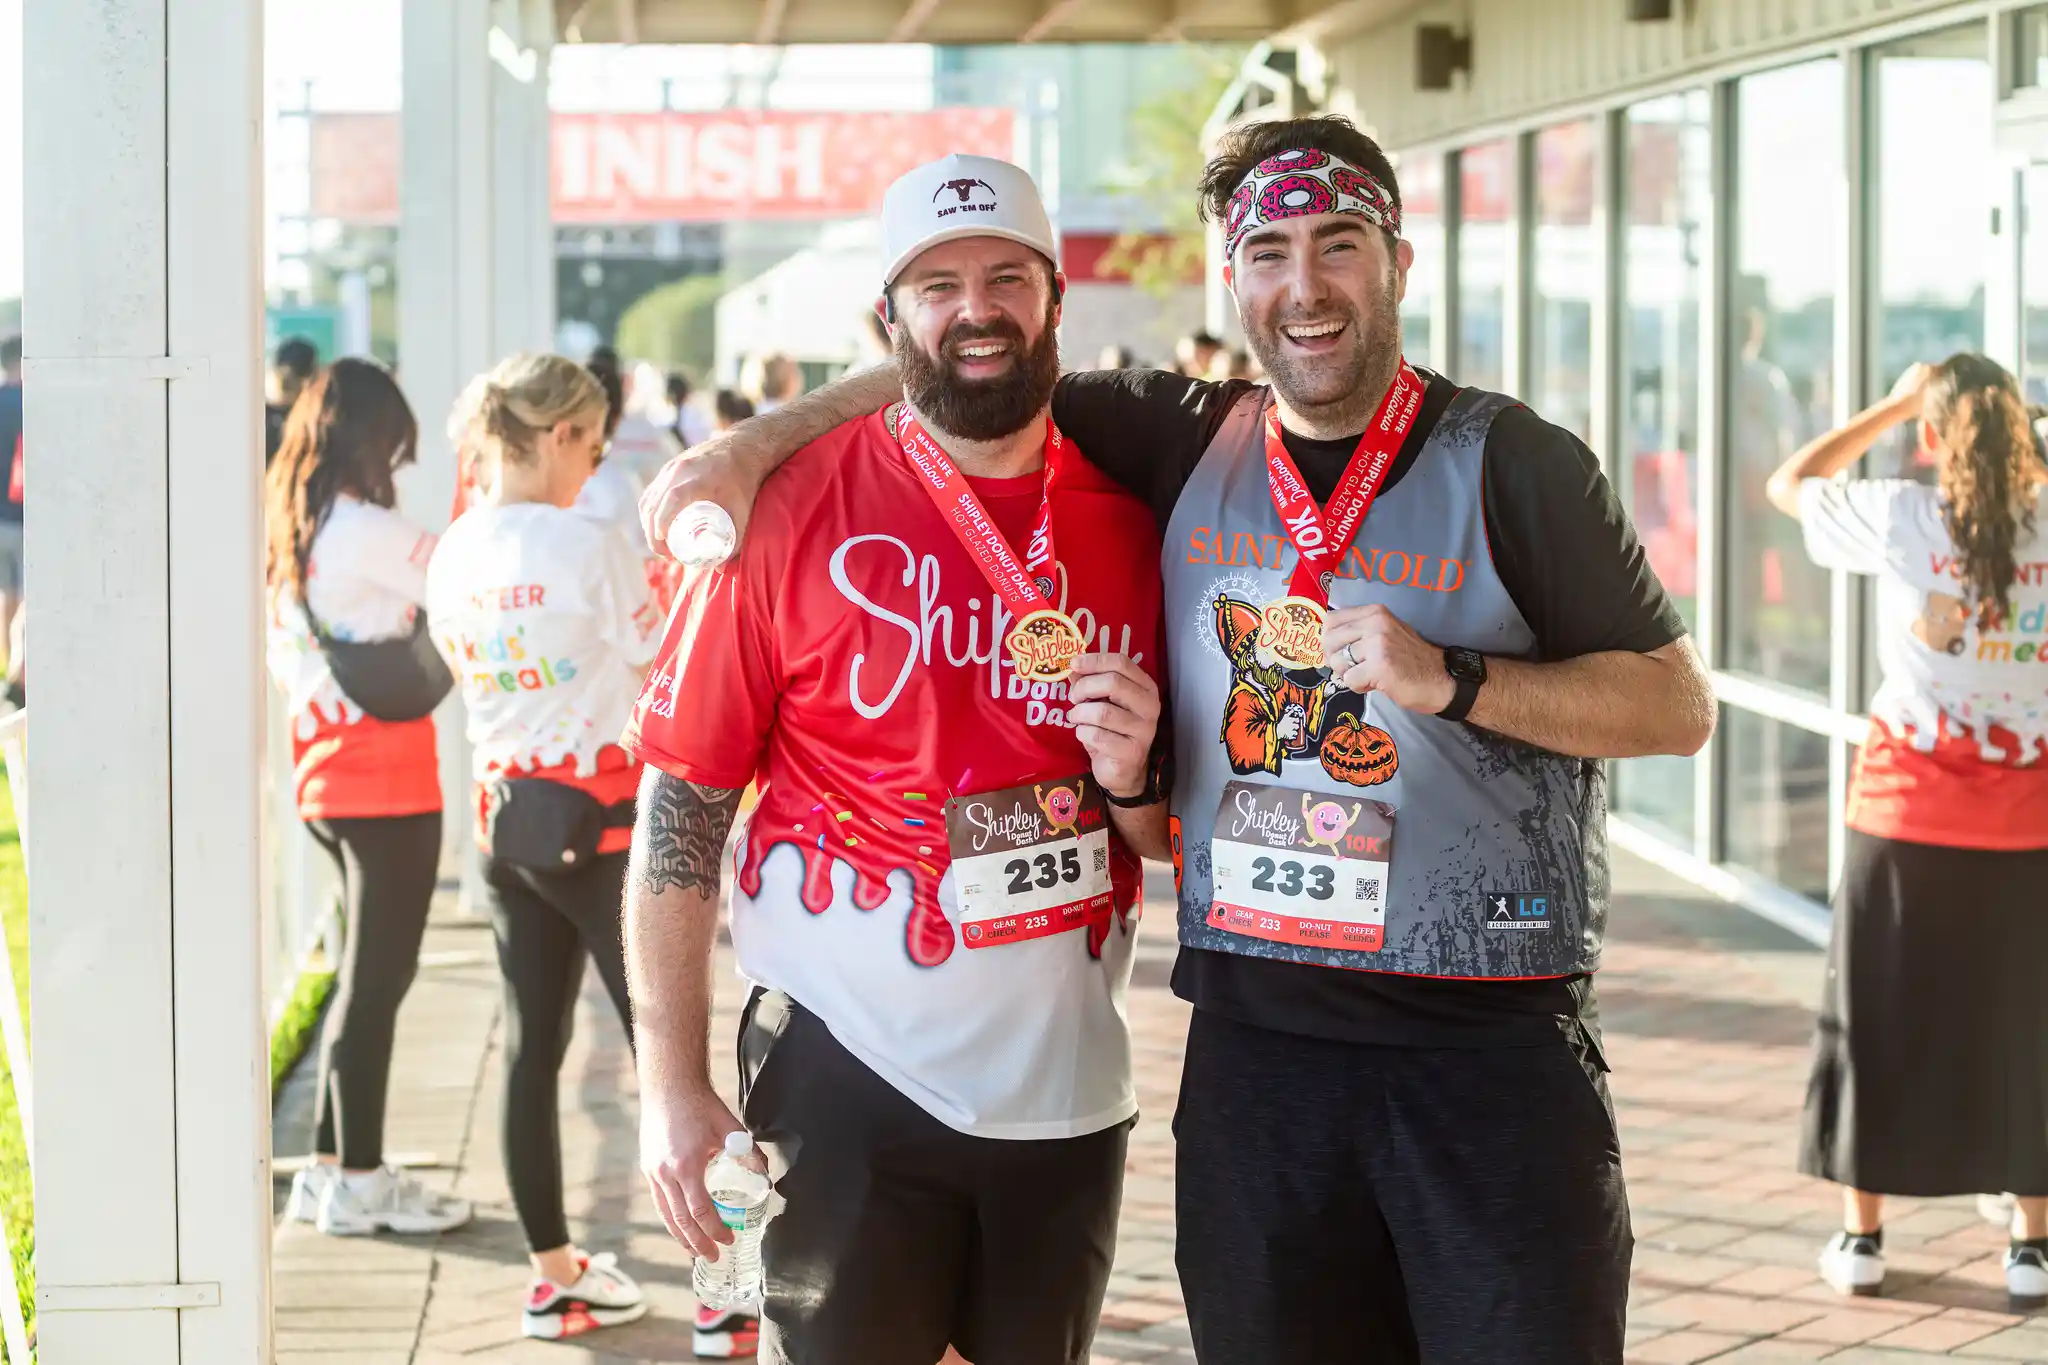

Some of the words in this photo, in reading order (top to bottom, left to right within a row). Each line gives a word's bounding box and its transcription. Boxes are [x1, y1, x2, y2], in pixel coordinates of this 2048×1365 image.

[560, 122, 824, 199] INISH
[937, 206, 957, 218] SAW
[959, 204, 977, 212] 'EM
[979, 204, 996, 212] OFF
[1380, 373, 1410, 432] Delicious
[1404, 390, 1420, 416] MAKE
[899, 403, 914, 438] 0K
[1394, 414, 1410, 434] LIFE
[904, 439, 946, 489] Delicious
[916, 432, 940, 459] MAKE
[937, 456, 954, 477] LIFE
[1355, 450, 1373, 475] HOT
[1271, 456, 1309, 503] Delicious
[1357, 450, 1388, 499] SHIPLEY
[1273, 484, 1289, 509] MAKE
[1332, 475, 1359, 516] GLAZED
[1286, 504, 1329, 561] 10K
[1334, 497, 1363, 543] DONUT
[950, 506, 970, 527] HOT
[965, 528, 993, 563] GLAZED
[989, 564, 1021, 602] DONUTS
[958, 493, 993, 537] SHIPLEY
[986, 536, 1018, 573] DONUT
[1011, 572, 1038, 602] DASH
[1186, 527, 1295, 570] SAINT
[1282, 546, 1466, 593] NOLD
[1986, 597, 2048, 633] kid
[472, 656, 577, 694] meals
[1007, 674, 1072, 702] Don
[1026, 700, 1078, 729] Da
[966, 801, 1041, 851] Shipley
[1078, 806, 1102, 828] 10K
[1232, 789, 1300, 846] Shipley
[1011, 830, 1033, 841] Donut
[1015, 836, 1034, 846] Dash
[1265, 830, 1288, 841] Donut
[1268, 837, 1287, 847] Dash
[1344, 833, 1382, 855] 10K
[1004, 847, 1081, 895] 235
[1252, 856, 1335, 900] 233
[987, 928, 1017, 938] CHECK
[993, 919, 1017, 929] GEAR
[1025, 914, 1048, 929] 235
[1062, 903, 1085, 915] DO-NUT
[1228, 916, 1253, 928] CHECK
[1299, 930, 1331, 939] PLEASE
[1342, 934, 1376, 944] NEEDED
[1235, 909, 1255, 919] GEAR
[1259, 917, 1281, 931] 233
[1299, 921, 1333, 931] DO-NUT
[1342, 925, 1377, 935] COFFEE
